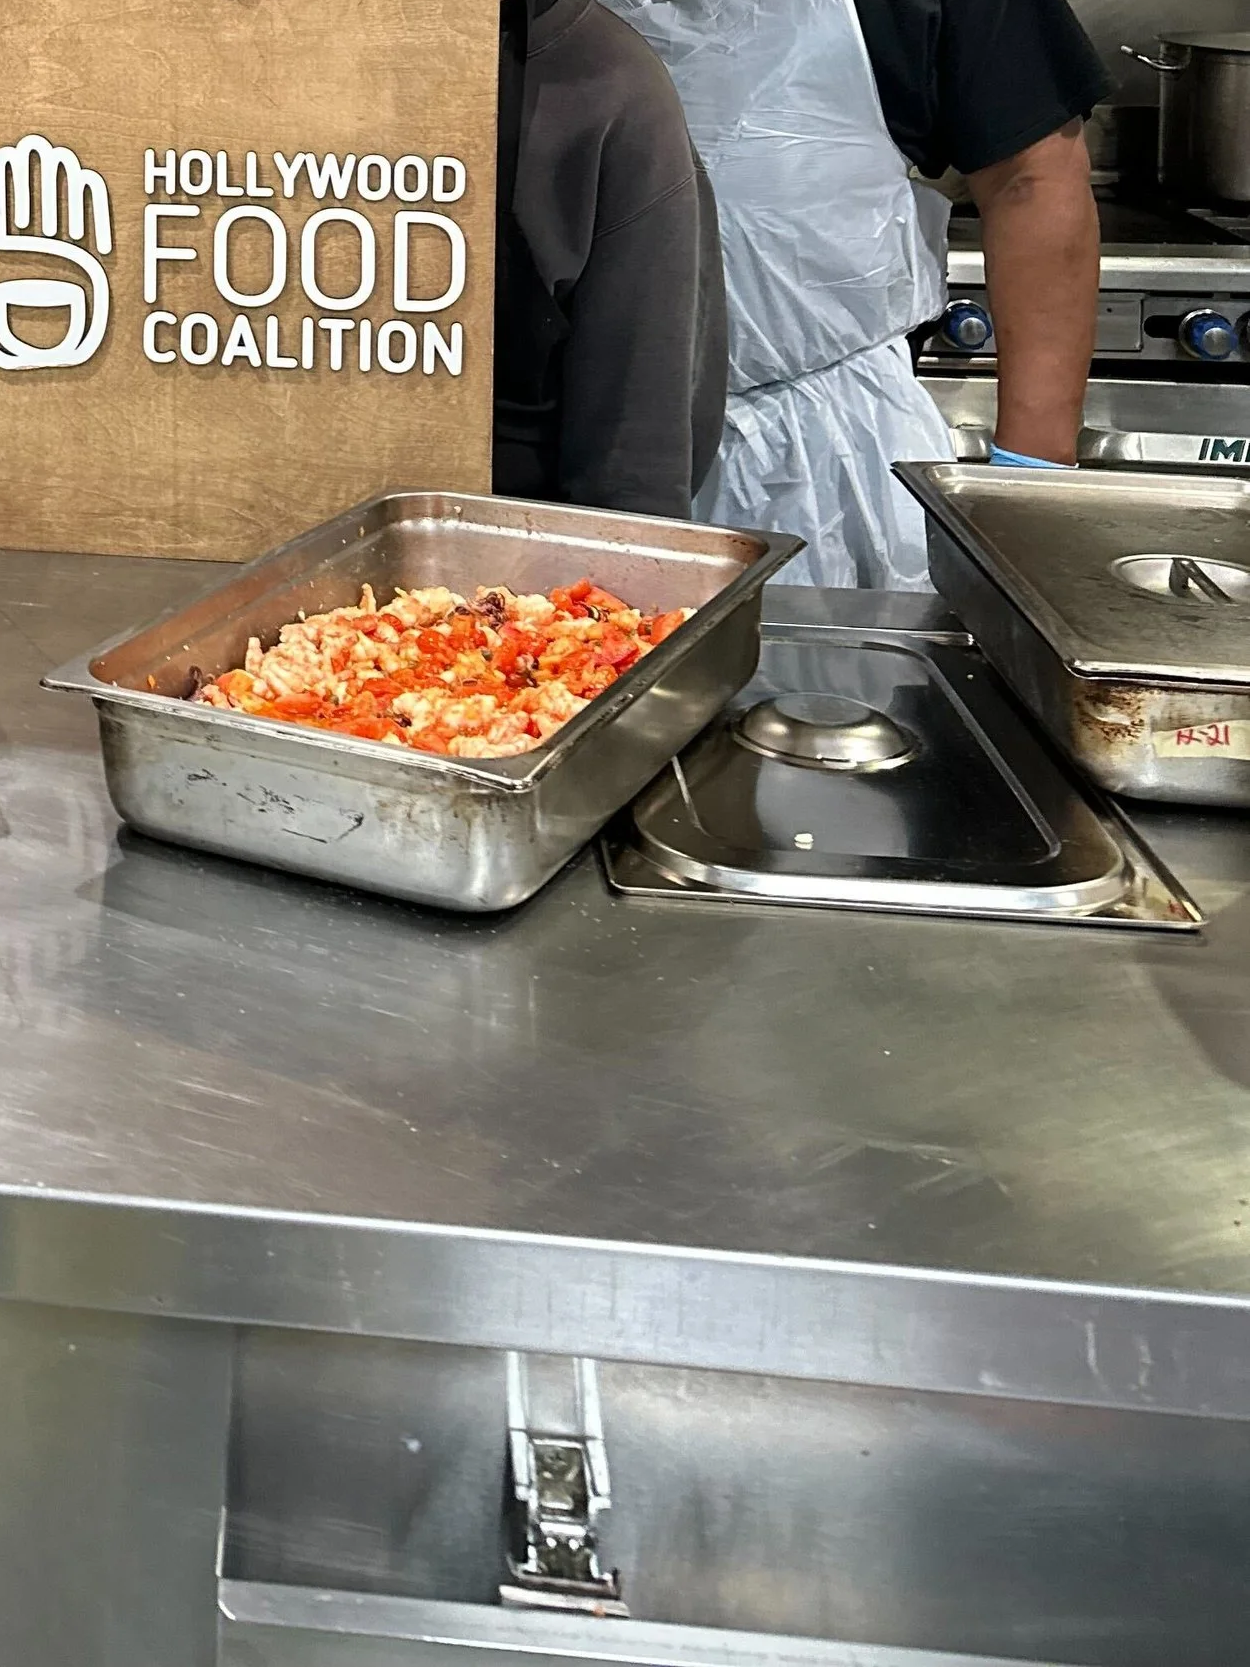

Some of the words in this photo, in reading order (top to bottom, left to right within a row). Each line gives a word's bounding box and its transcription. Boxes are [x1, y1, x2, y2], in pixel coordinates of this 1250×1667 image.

[144, 148, 466, 202] HOLLYWOOD
[143, 203, 466, 312] FOOD
[143, 310, 463, 376] COALITION
